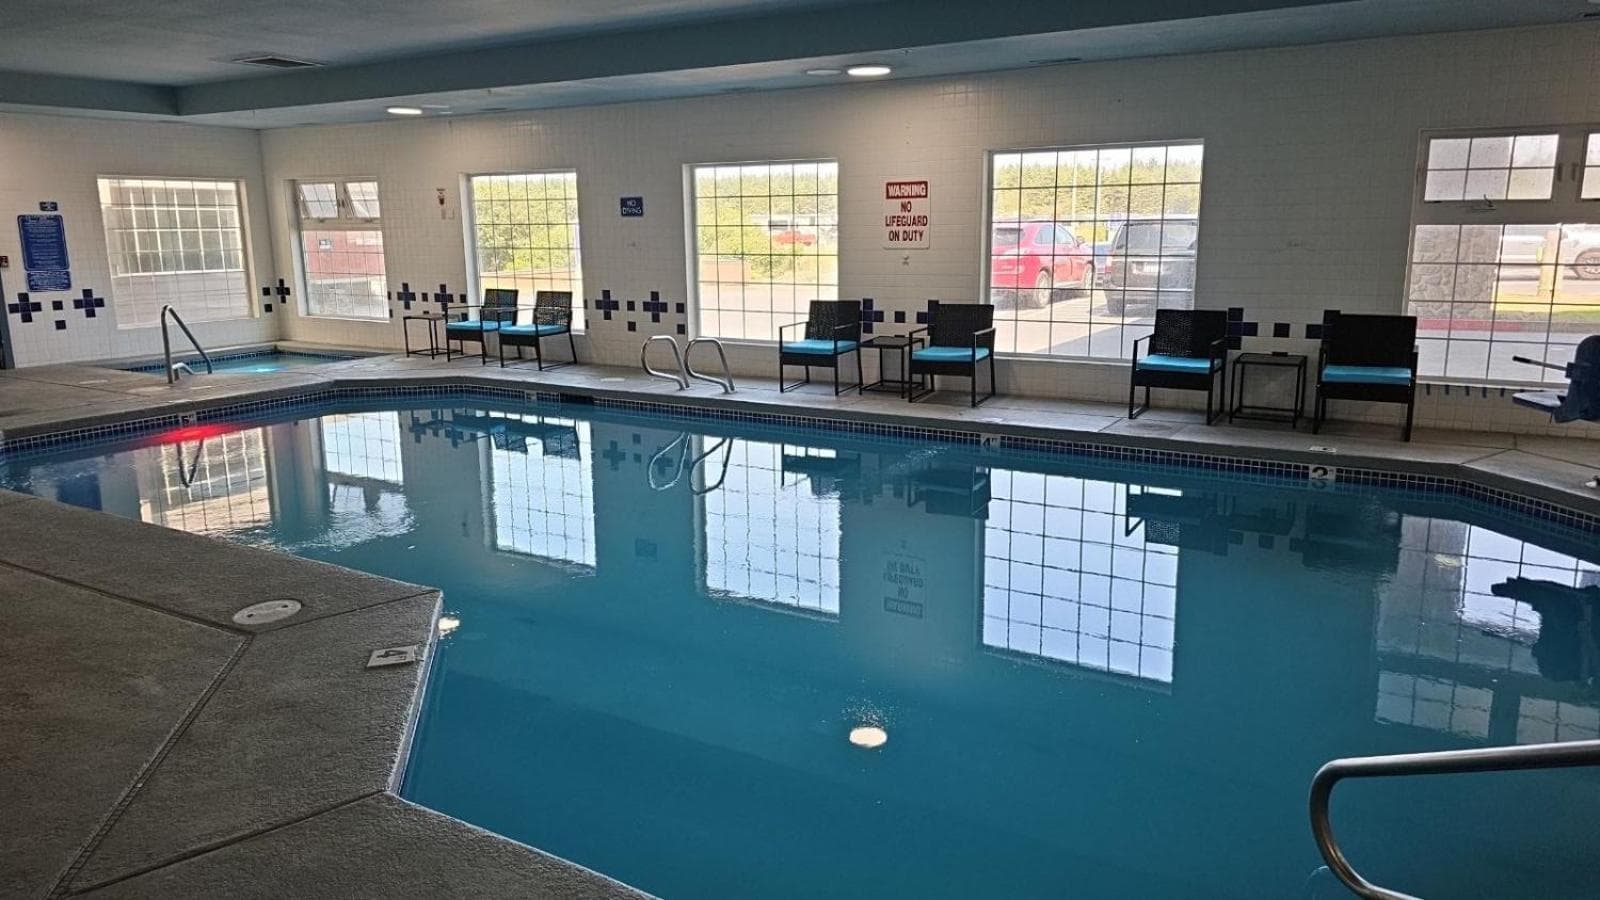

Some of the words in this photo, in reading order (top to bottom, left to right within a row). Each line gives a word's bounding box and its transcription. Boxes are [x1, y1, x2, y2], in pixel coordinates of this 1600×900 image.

[887, 183, 927, 197] WARNING
[900, 201, 912, 213] NO
[885, 215, 928, 227] LIFEGUARD
[888, 230, 900, 241] ON
[902, 230, 924, 241] DUTY
